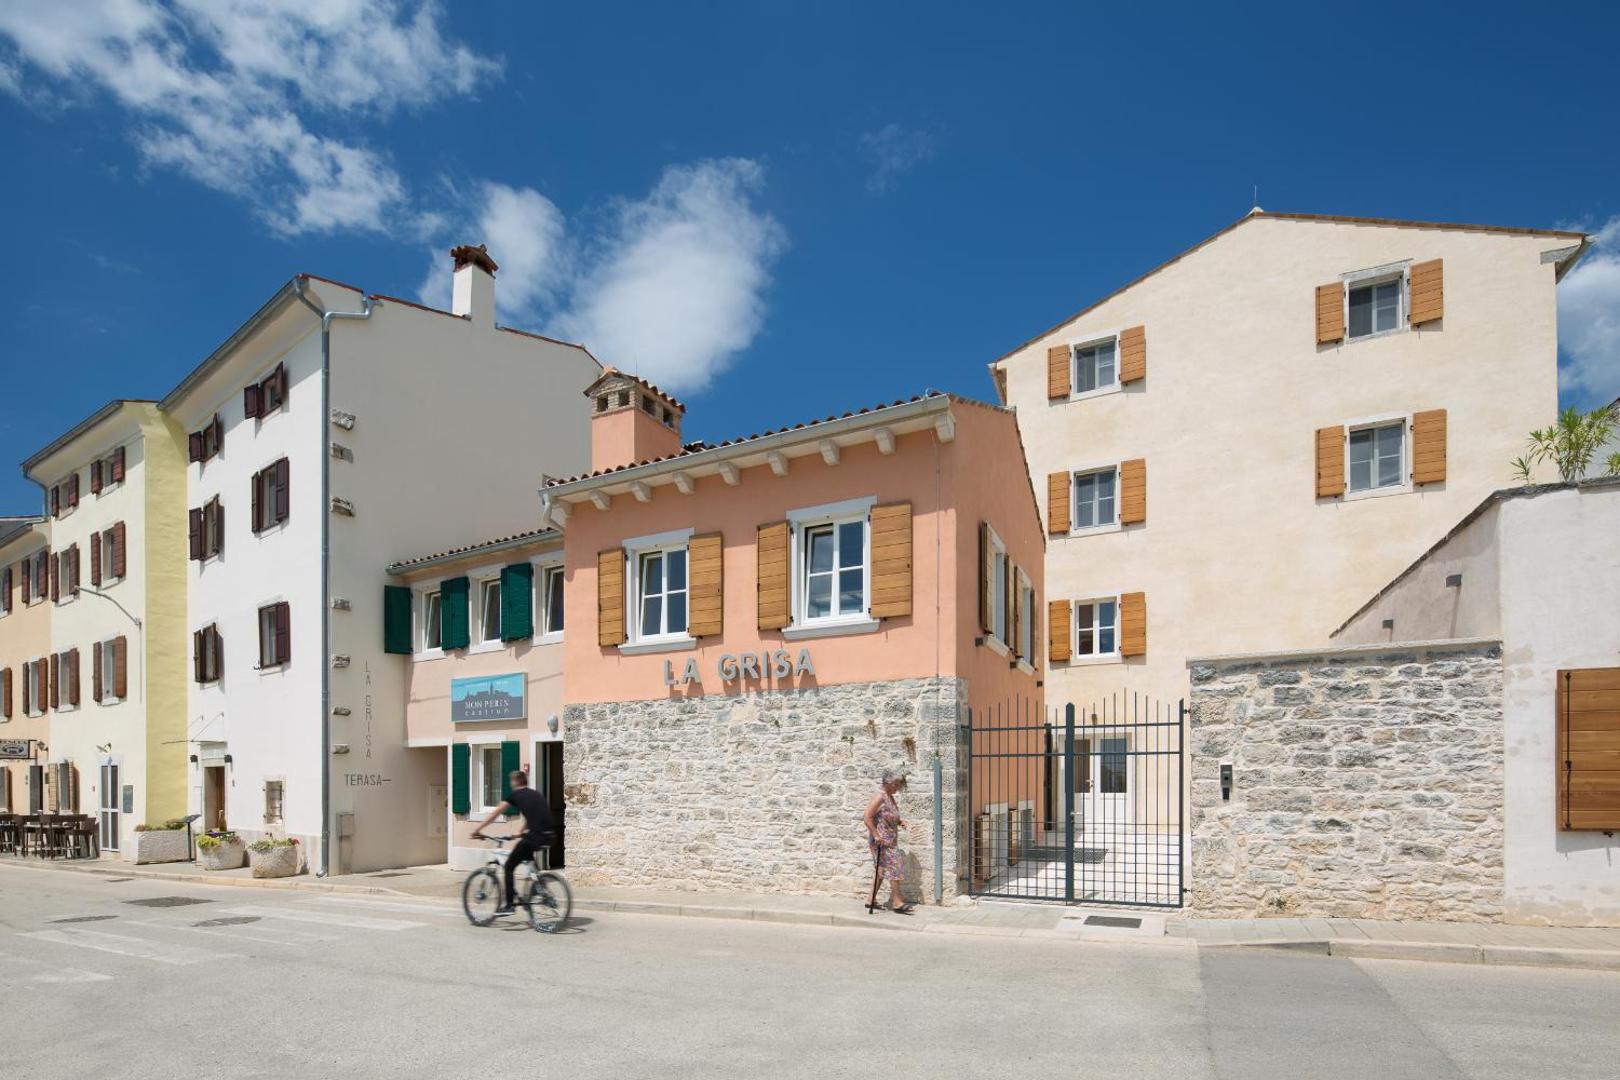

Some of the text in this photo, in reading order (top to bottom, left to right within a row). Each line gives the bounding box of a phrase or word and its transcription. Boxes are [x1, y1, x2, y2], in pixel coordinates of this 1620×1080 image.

[365, 659, 372, 686] LA
[663, 648, 815, 686] LA GRISA
